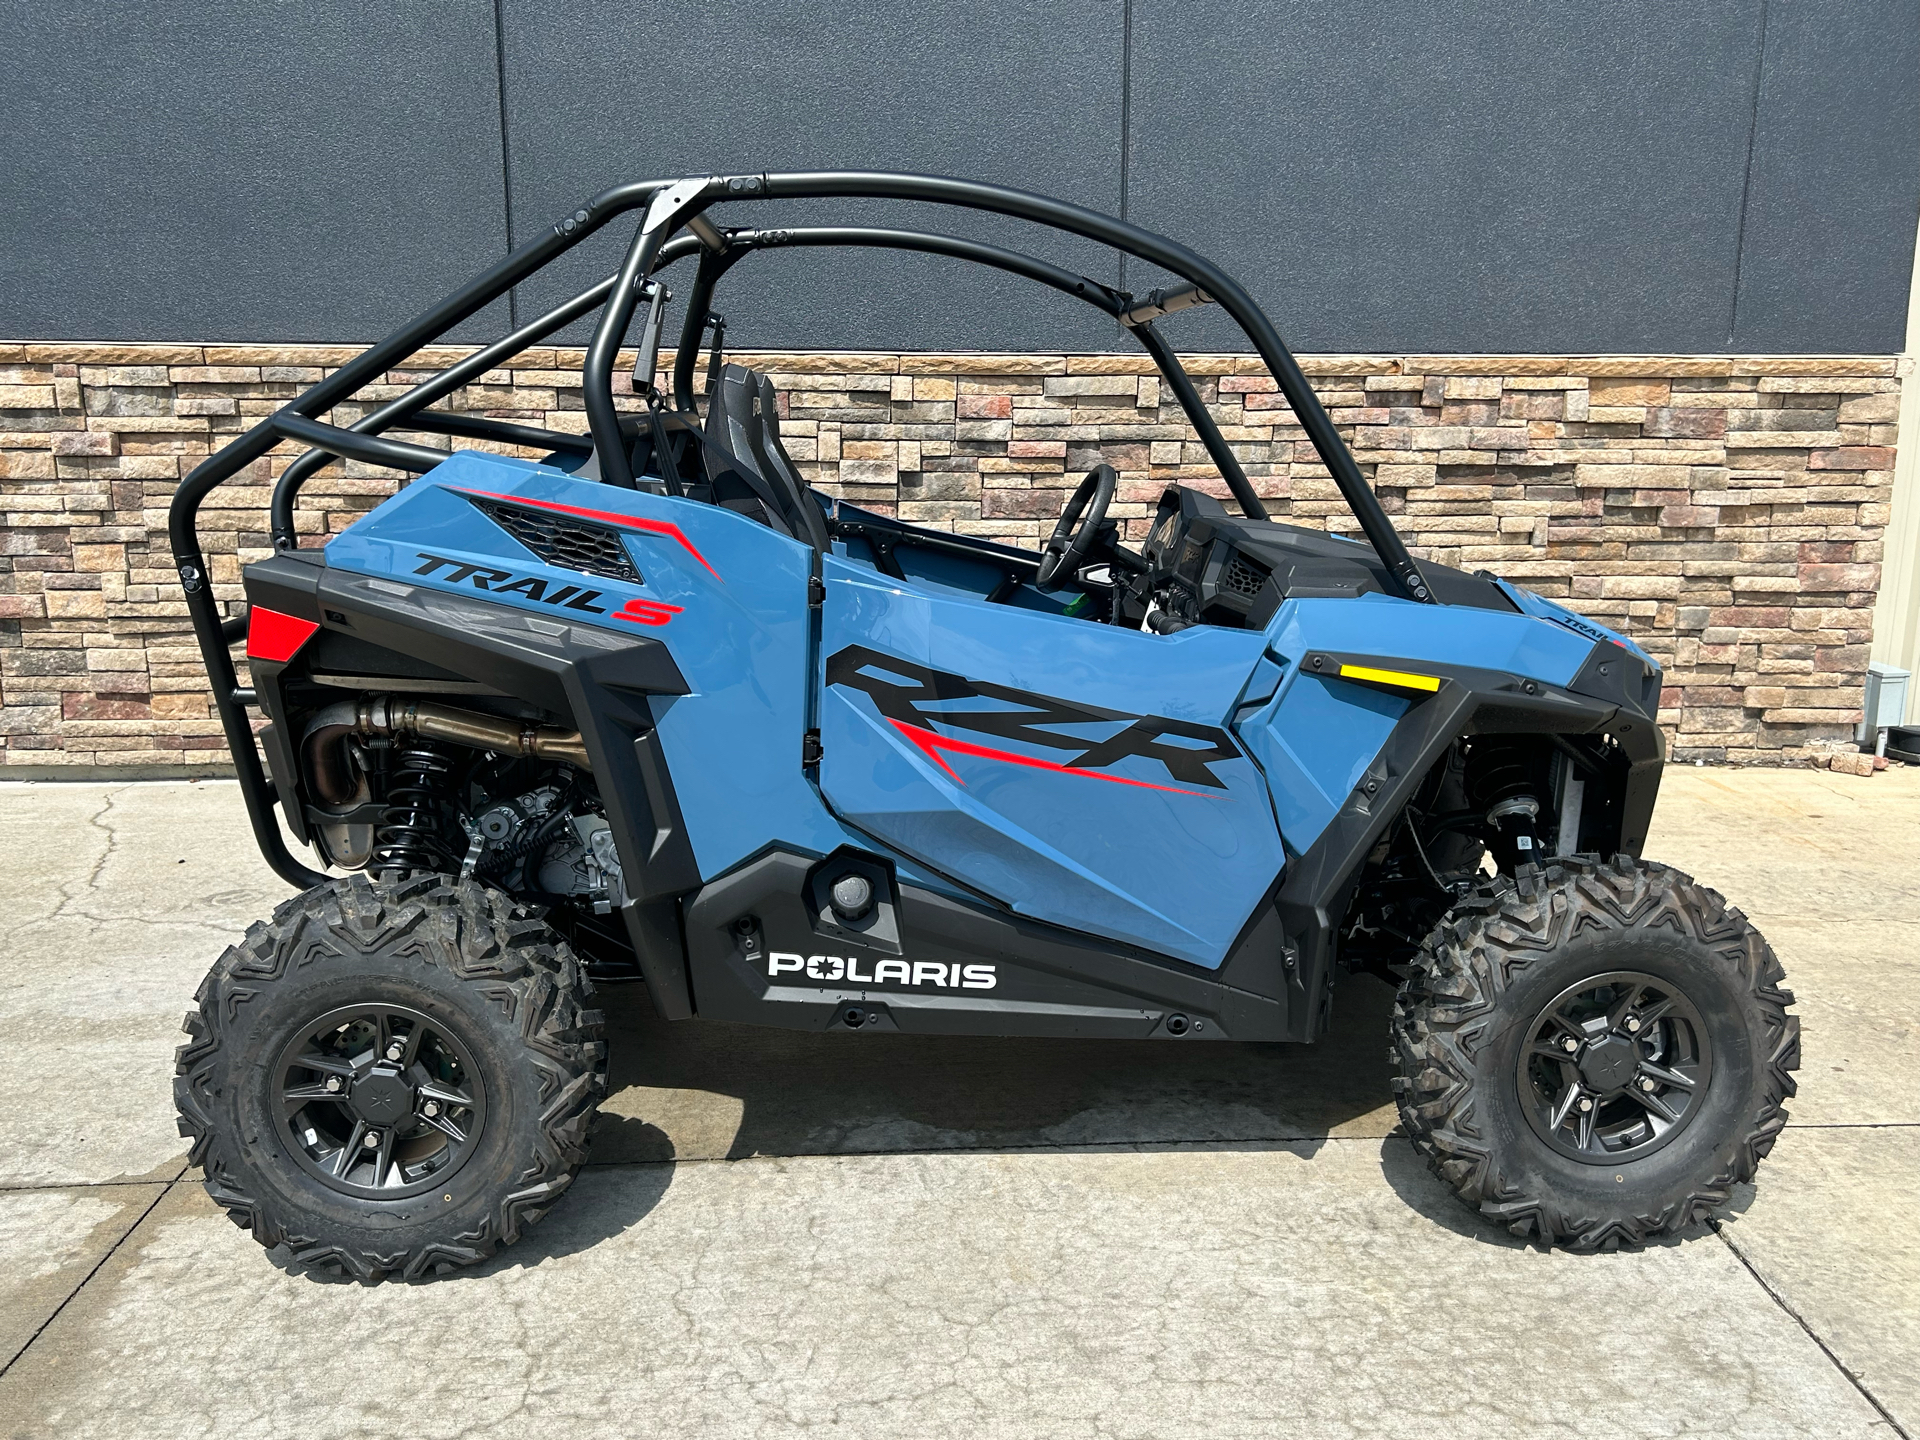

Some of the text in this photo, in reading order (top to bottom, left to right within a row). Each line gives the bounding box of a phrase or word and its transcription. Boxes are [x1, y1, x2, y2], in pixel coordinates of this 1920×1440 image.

[412, 552, 686, 627] TRAIL S
[825, 643, 1244, 791] RZR
[768, 952, 997, 989] POLARIS
